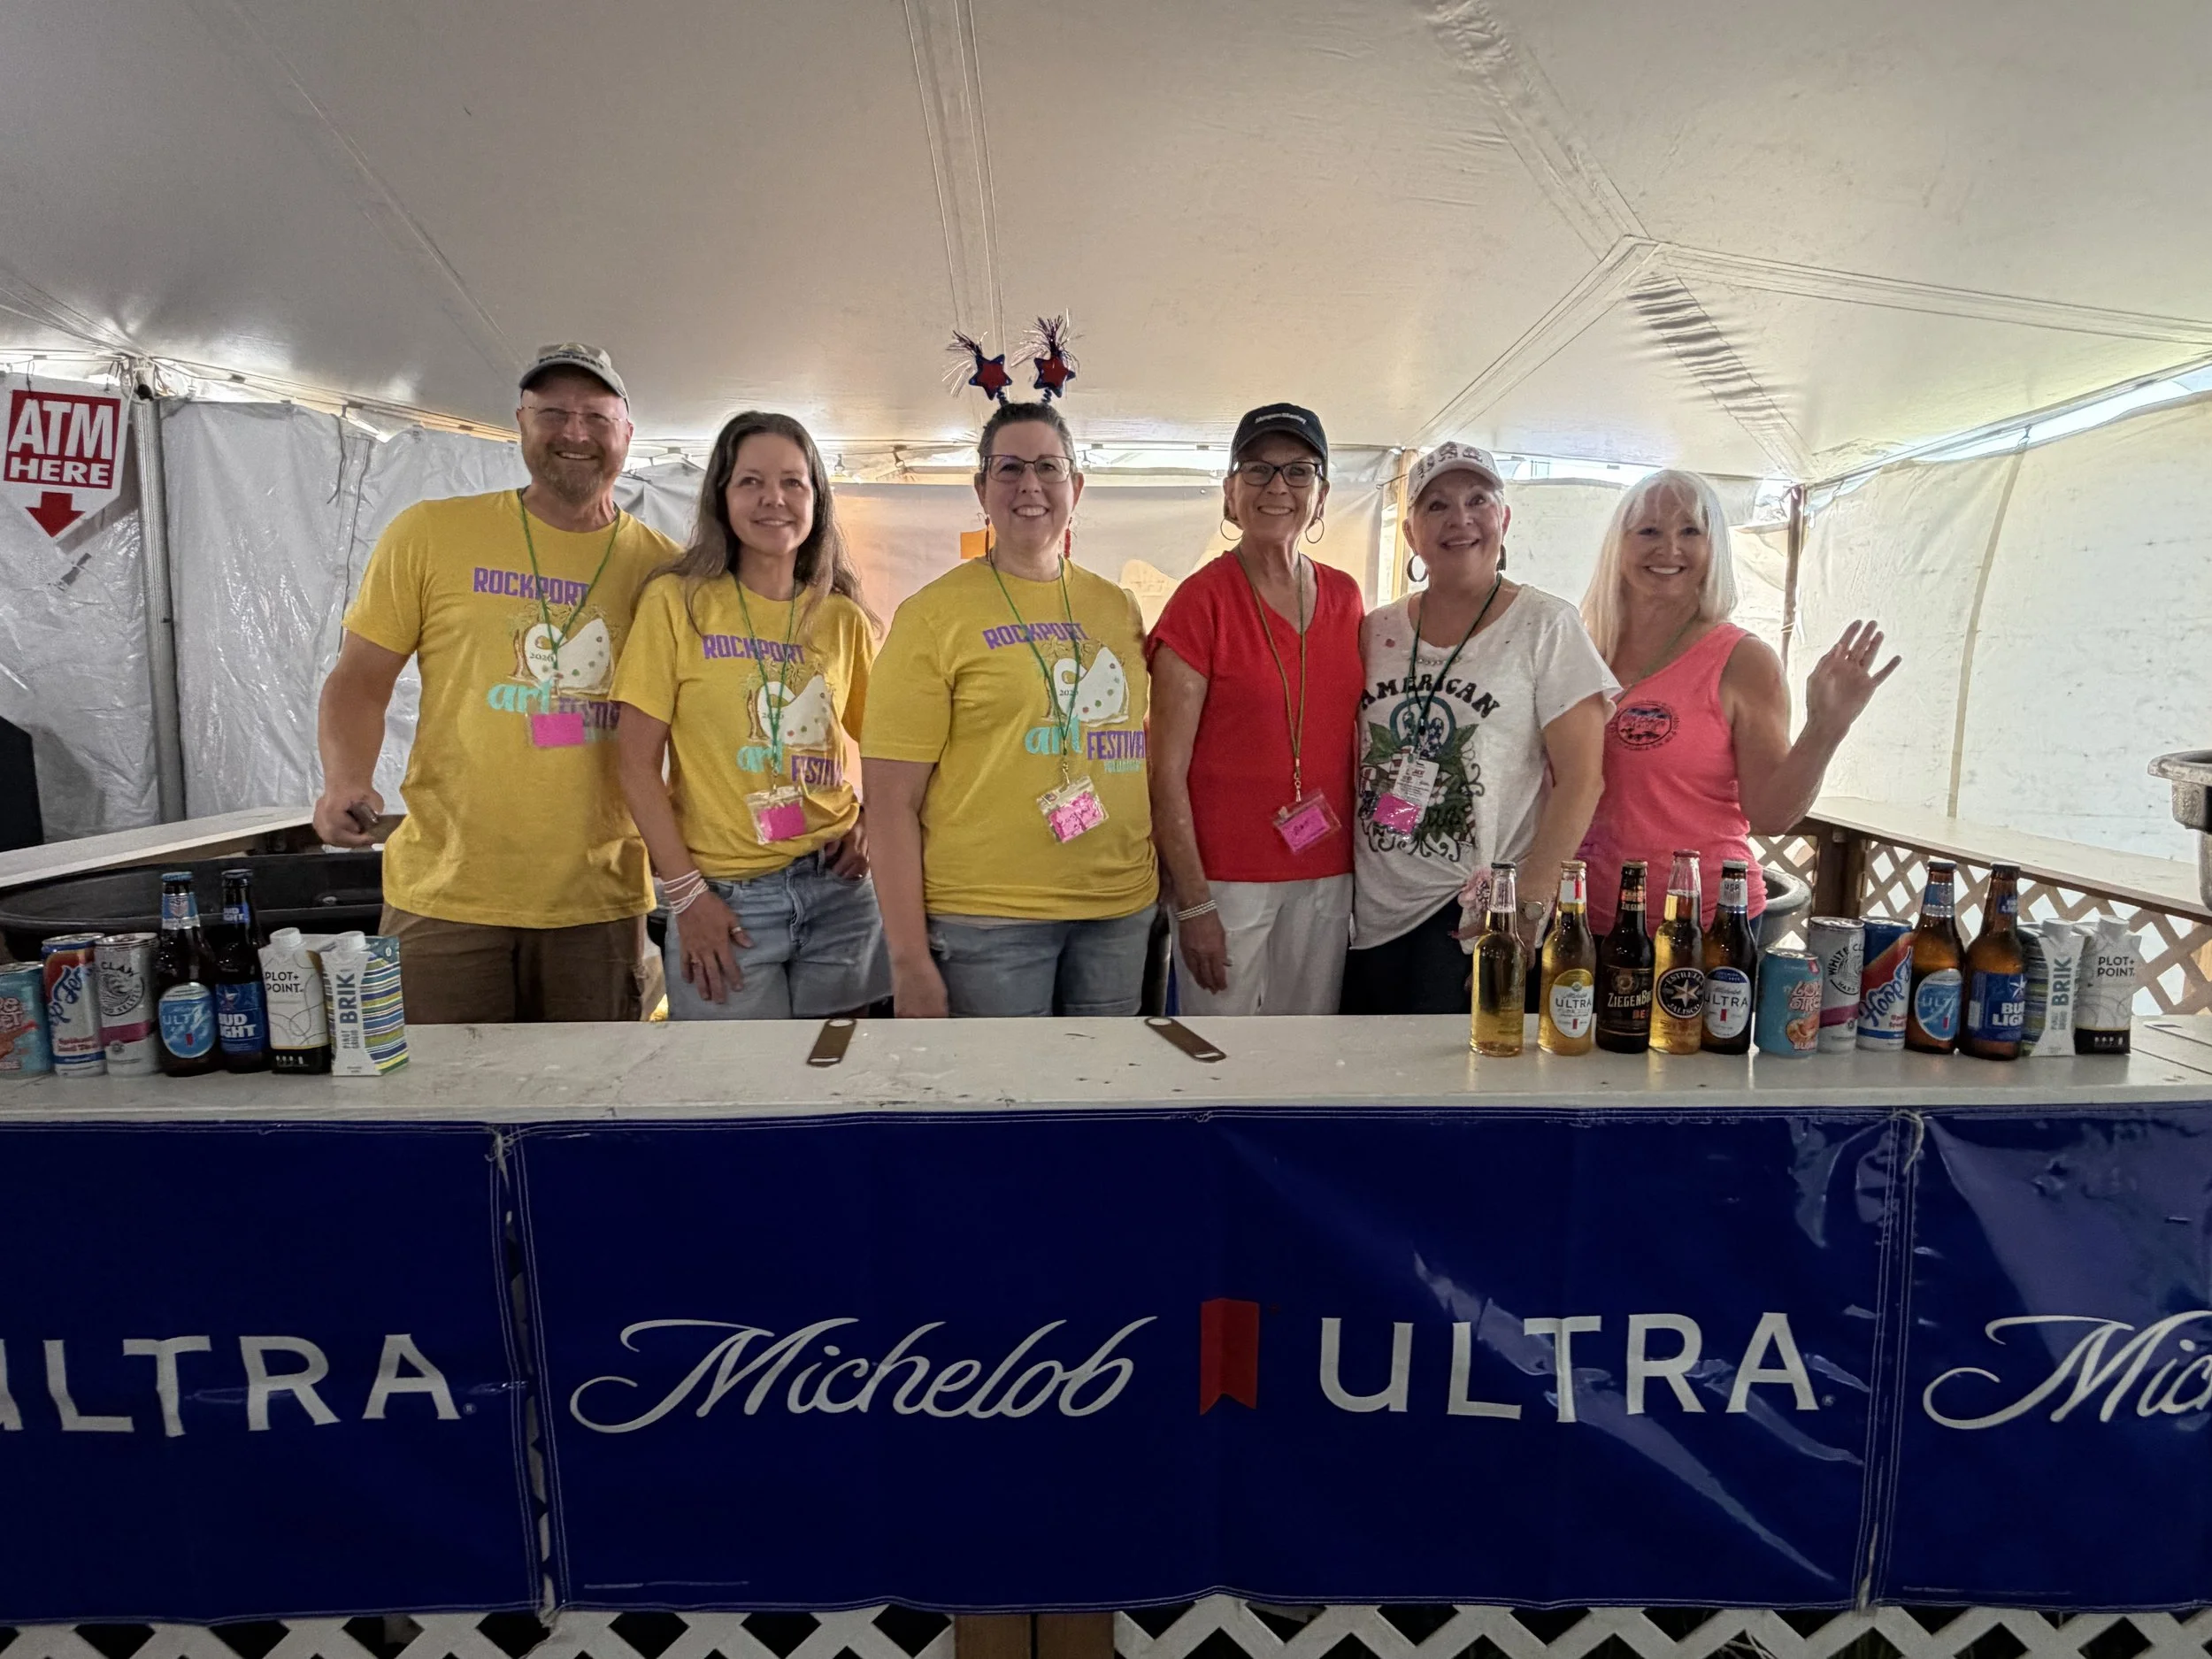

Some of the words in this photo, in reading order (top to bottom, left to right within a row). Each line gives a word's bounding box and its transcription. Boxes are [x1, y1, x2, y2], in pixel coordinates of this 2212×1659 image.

[8, 398, 113, 460] ATM
[9, 457, 110, 486] HERE
[473, 567, 590, 606] ROCKPORT
[703, 634, 805, 664] ROCKPORT
[982, 622, 1088, 649] ROCKPORT
[488, 678, 552, 715] art
[1360, 673, 1500, 718] AMERICAN
[1025, 715, 1083, 755] art
[1827, 944, 1850, 977] WHITE
[336, 973, 358, 1025] BRIK
[1704, 993, 1748, 1007] ULTRA
[2051, 956, 2072, 1006] BRIK
[1555, 997, 1592, 1010] ULTRA
[1858, 983, 1905, 1027] Hoop
[570, 1316, 1158, 1433] Michelob
[1319, 1312, 1819, 1423] ULTRA
